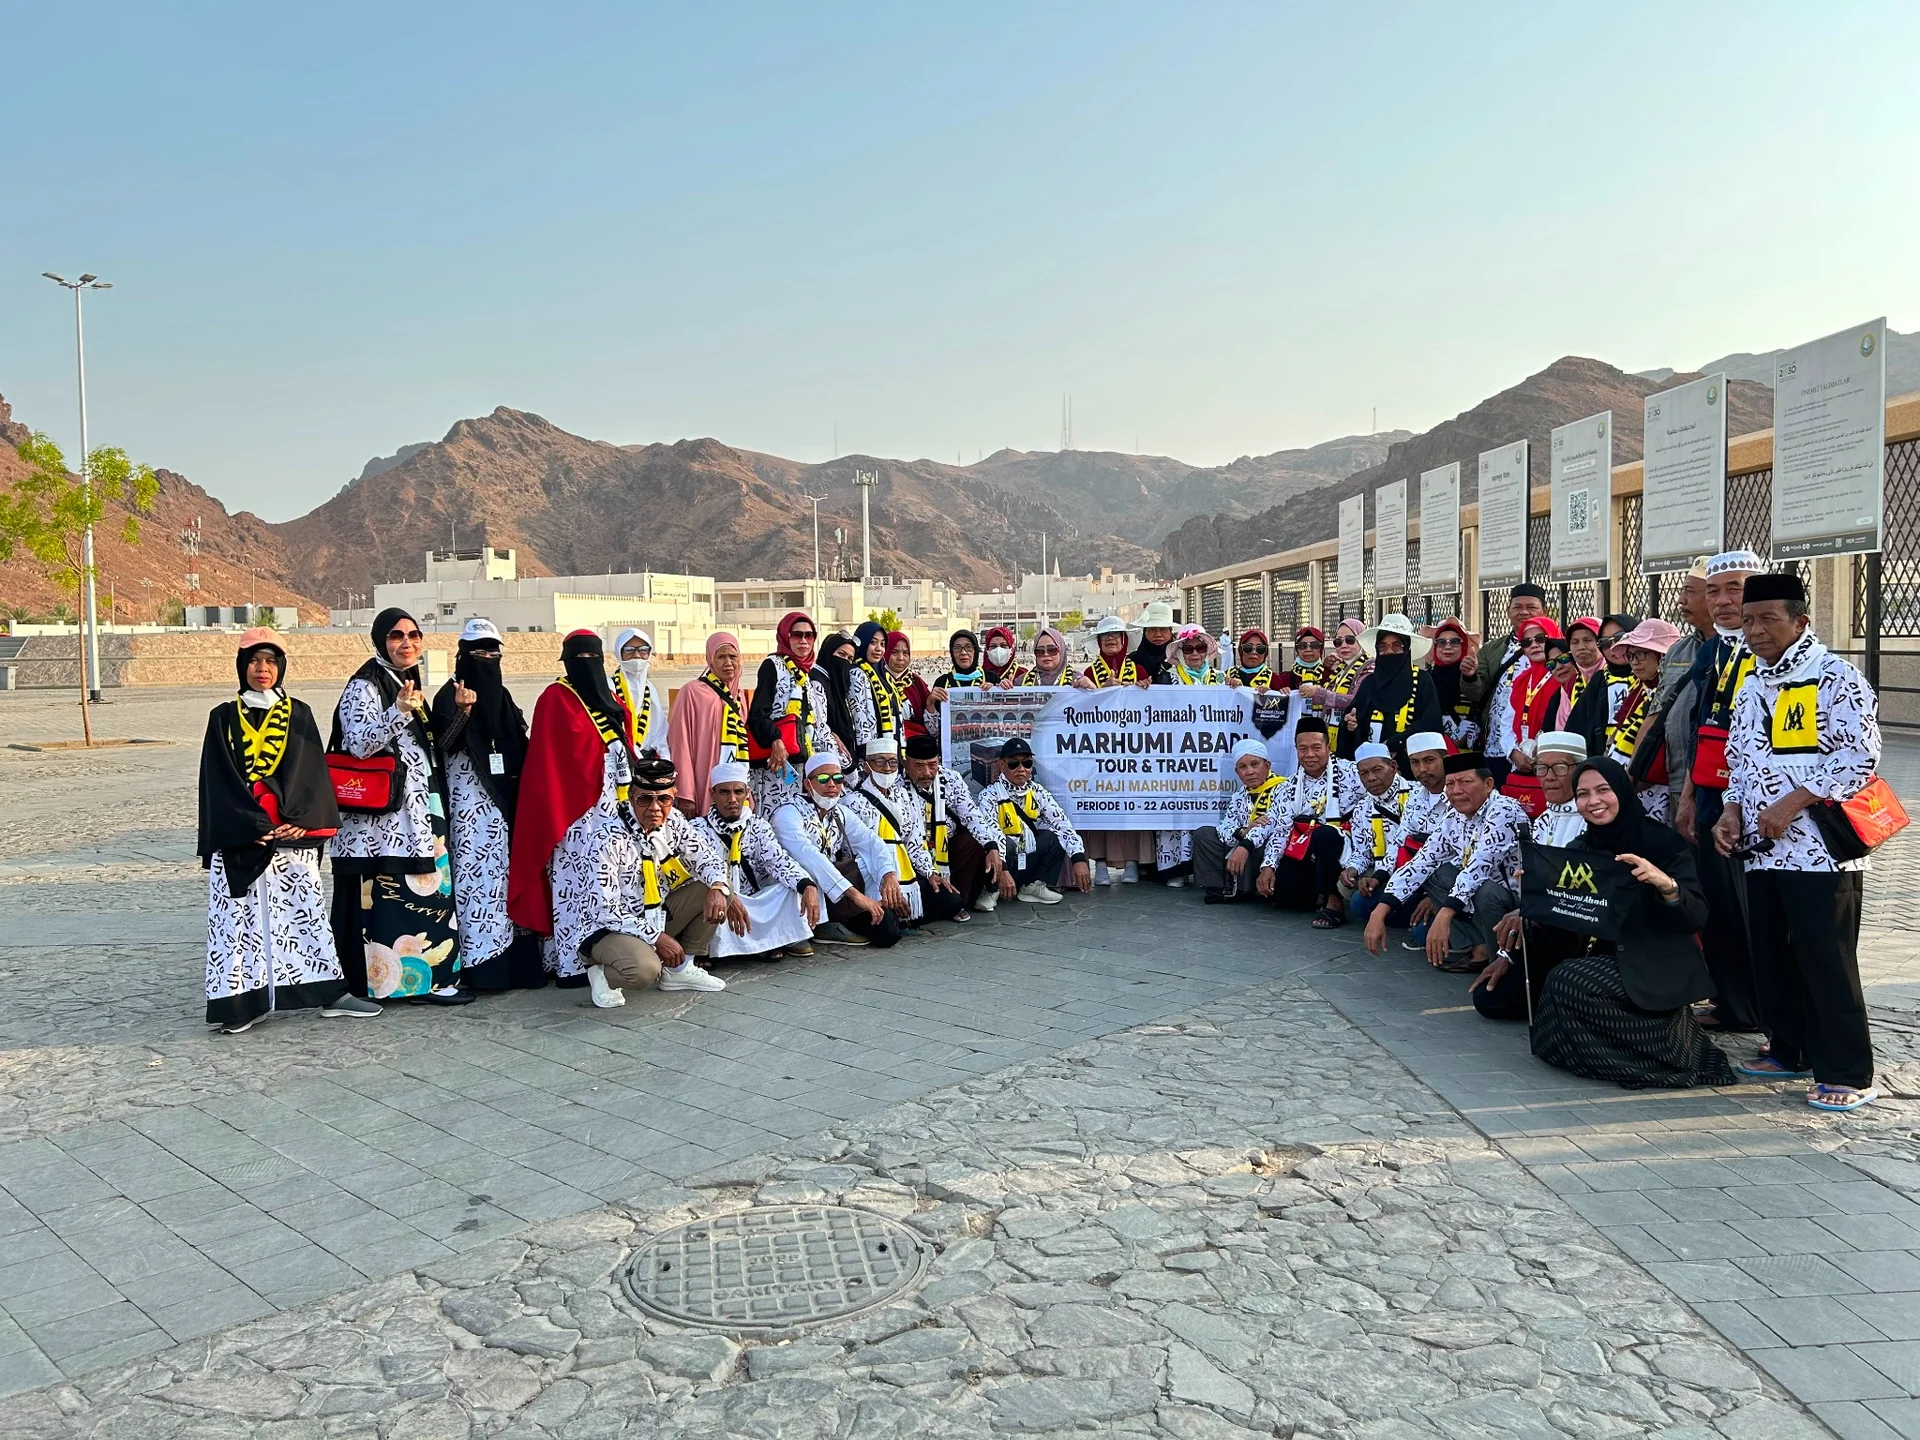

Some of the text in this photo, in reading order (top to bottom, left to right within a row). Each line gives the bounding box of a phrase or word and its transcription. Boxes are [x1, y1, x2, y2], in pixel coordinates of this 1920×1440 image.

[1063, 705, 1142, 728] Rombongan
[1144, 703, 1197, 727] Jamaah
[1199, 704, 1244, 725] Umrah
[1056, 732, 1173, 754] MARHUMI
[1095, 758, 1218, 773] TOUR & TRAVEL
[1068, 779, 1238, 793] (PT. HAJI MARHUMI ABADI)
[1076, 801, 1120, 811] PERIODE
[1123, 801, 1135, 811] 10
[1143, 801, 1157, 811] 22
[1159, 801, 1209, 811] AGUSTUS
